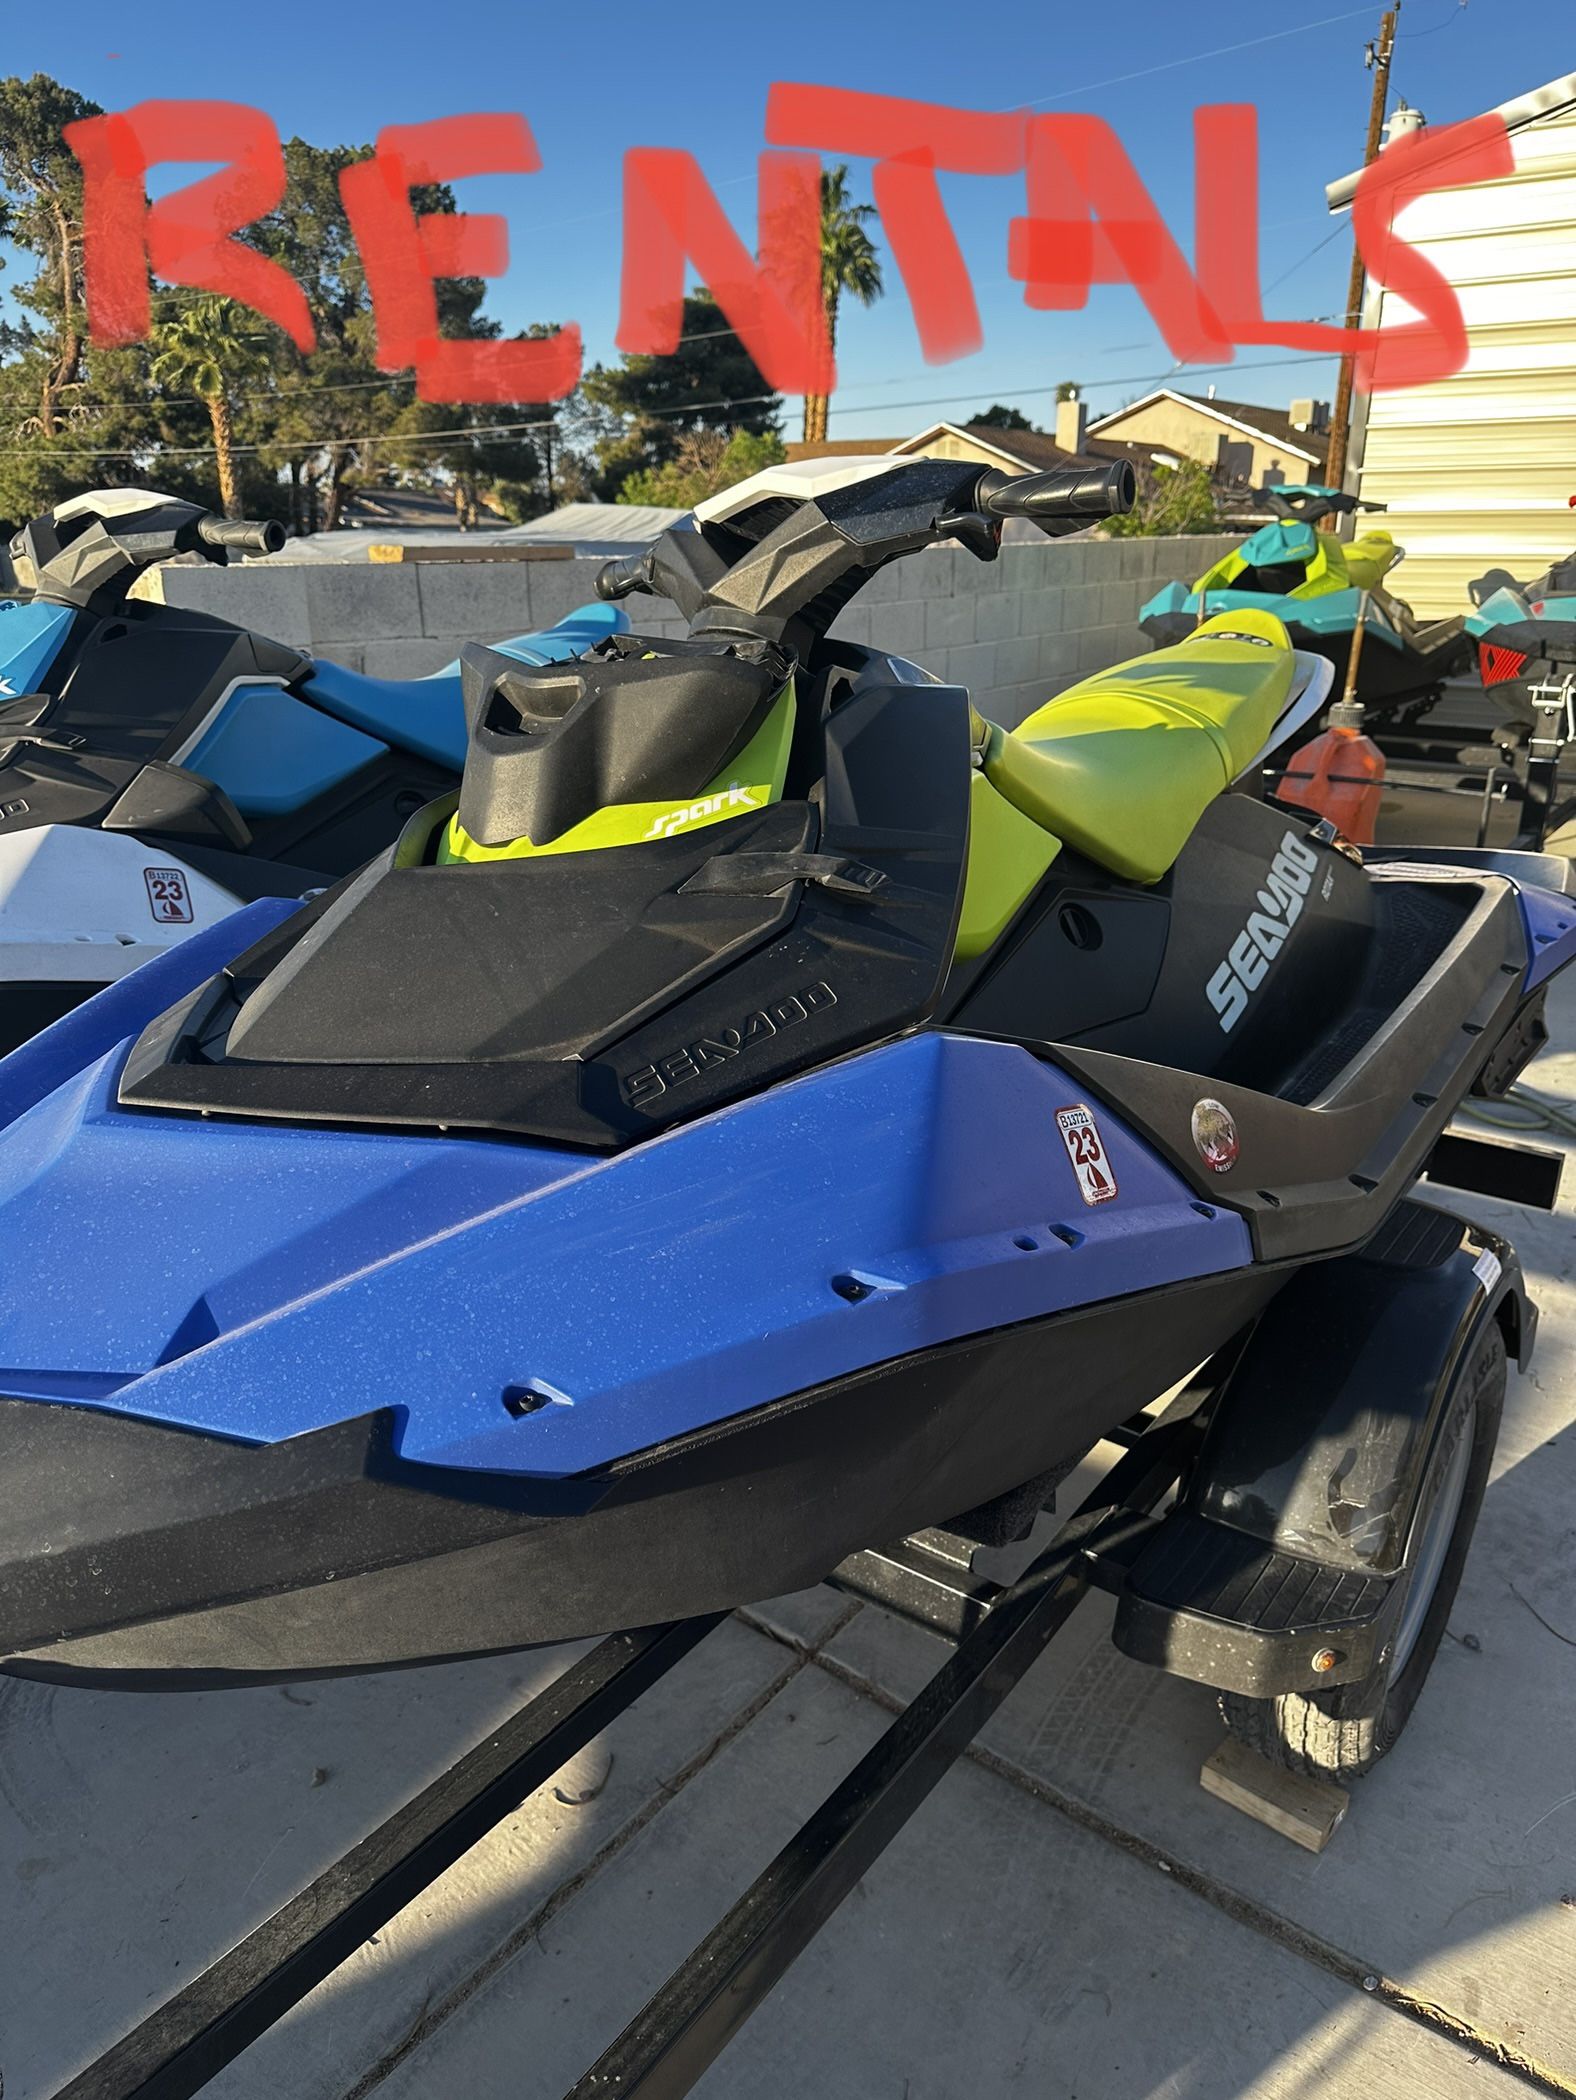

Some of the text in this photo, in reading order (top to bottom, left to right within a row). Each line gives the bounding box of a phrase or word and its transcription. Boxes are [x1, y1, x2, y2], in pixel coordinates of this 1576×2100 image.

[152, 880, 184, 900] 23
[1060, 1111, 1089, 1129] B13721
[1068, 1126, 1101, 1165] 23
